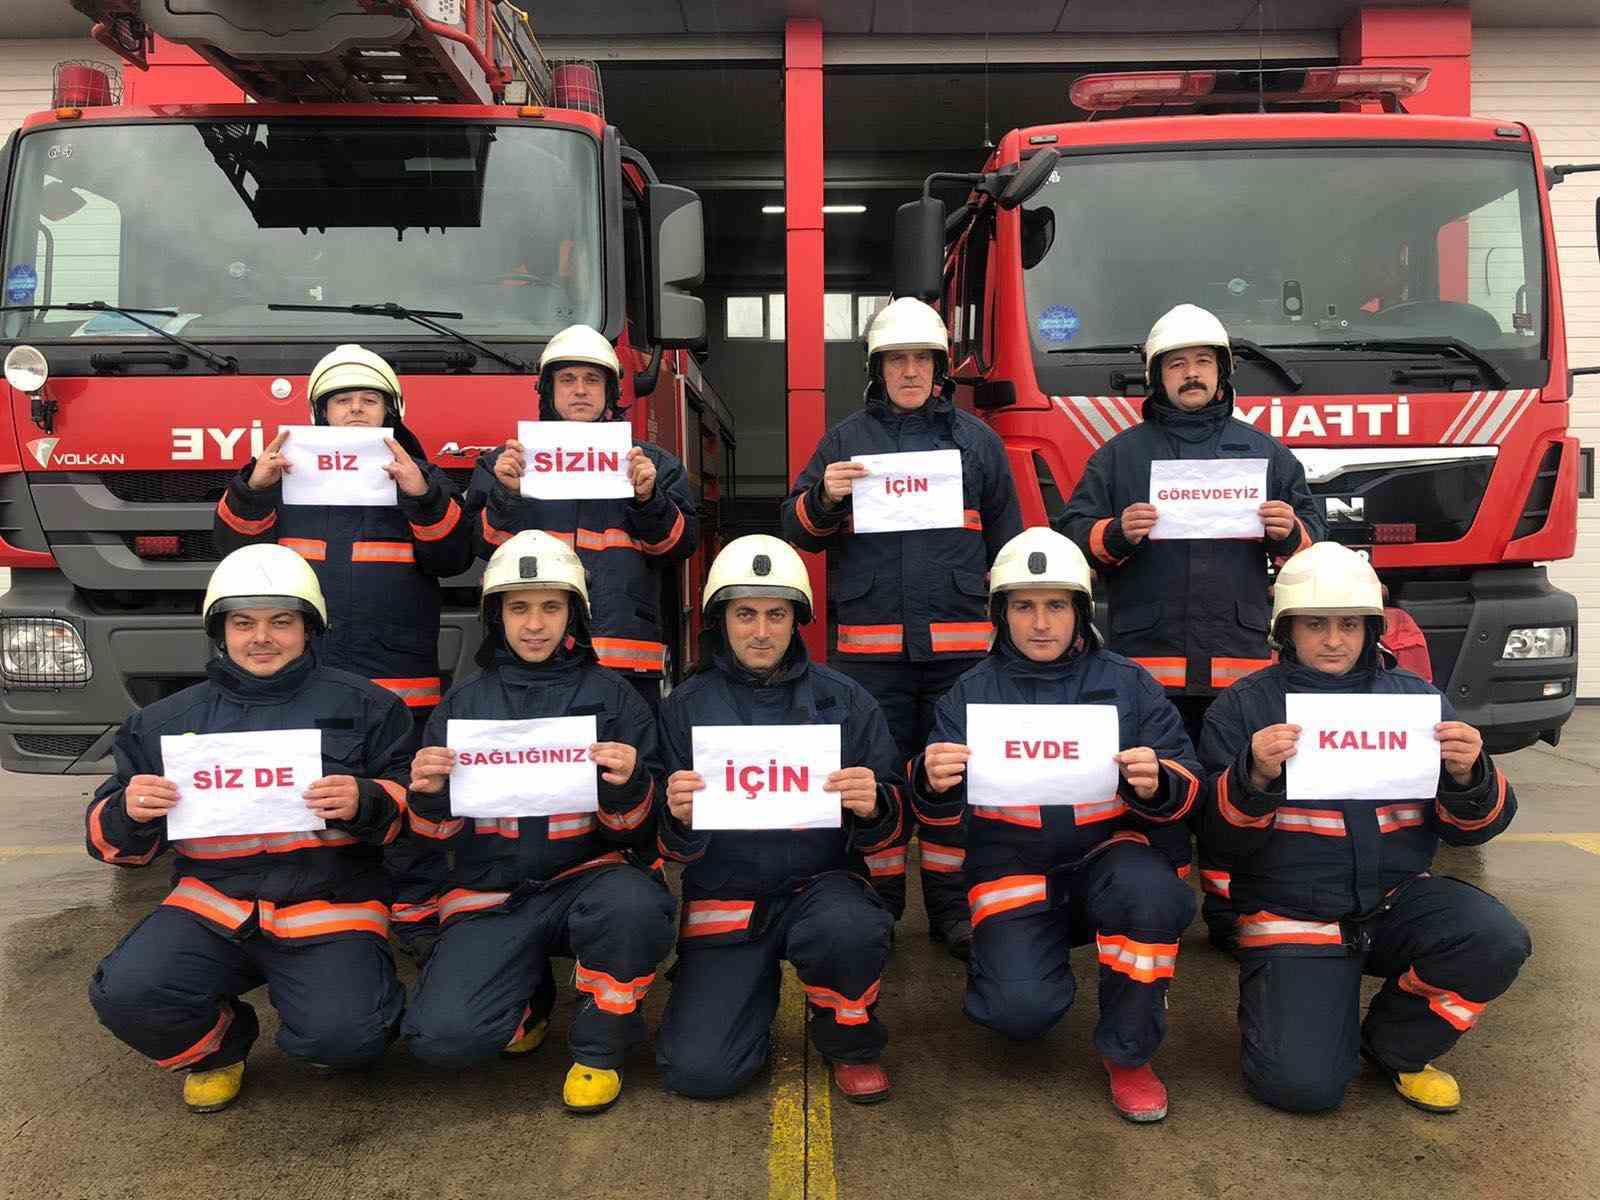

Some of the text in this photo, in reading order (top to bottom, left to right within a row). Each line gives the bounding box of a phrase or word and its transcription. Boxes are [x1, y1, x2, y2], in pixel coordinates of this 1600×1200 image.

[53, 452, 124, 465] VOLKAN
[317, 450, 358, 472] BİZ
[534, 448, 618, 473] SİZİN
[885, 476, 928, 497] İÇİN
[1157, 486, 1260, 501] GÖREVDEYİZ
[1004, 740, 1080, 761] EVDE
[1318, 730, 1408, 751] KALIN
[458, 747, 588, 766] SAĞLIĞINIZ
[192, 765, 295, 791] SİZ DE
[725, 758, 809, 800] İÇİN
